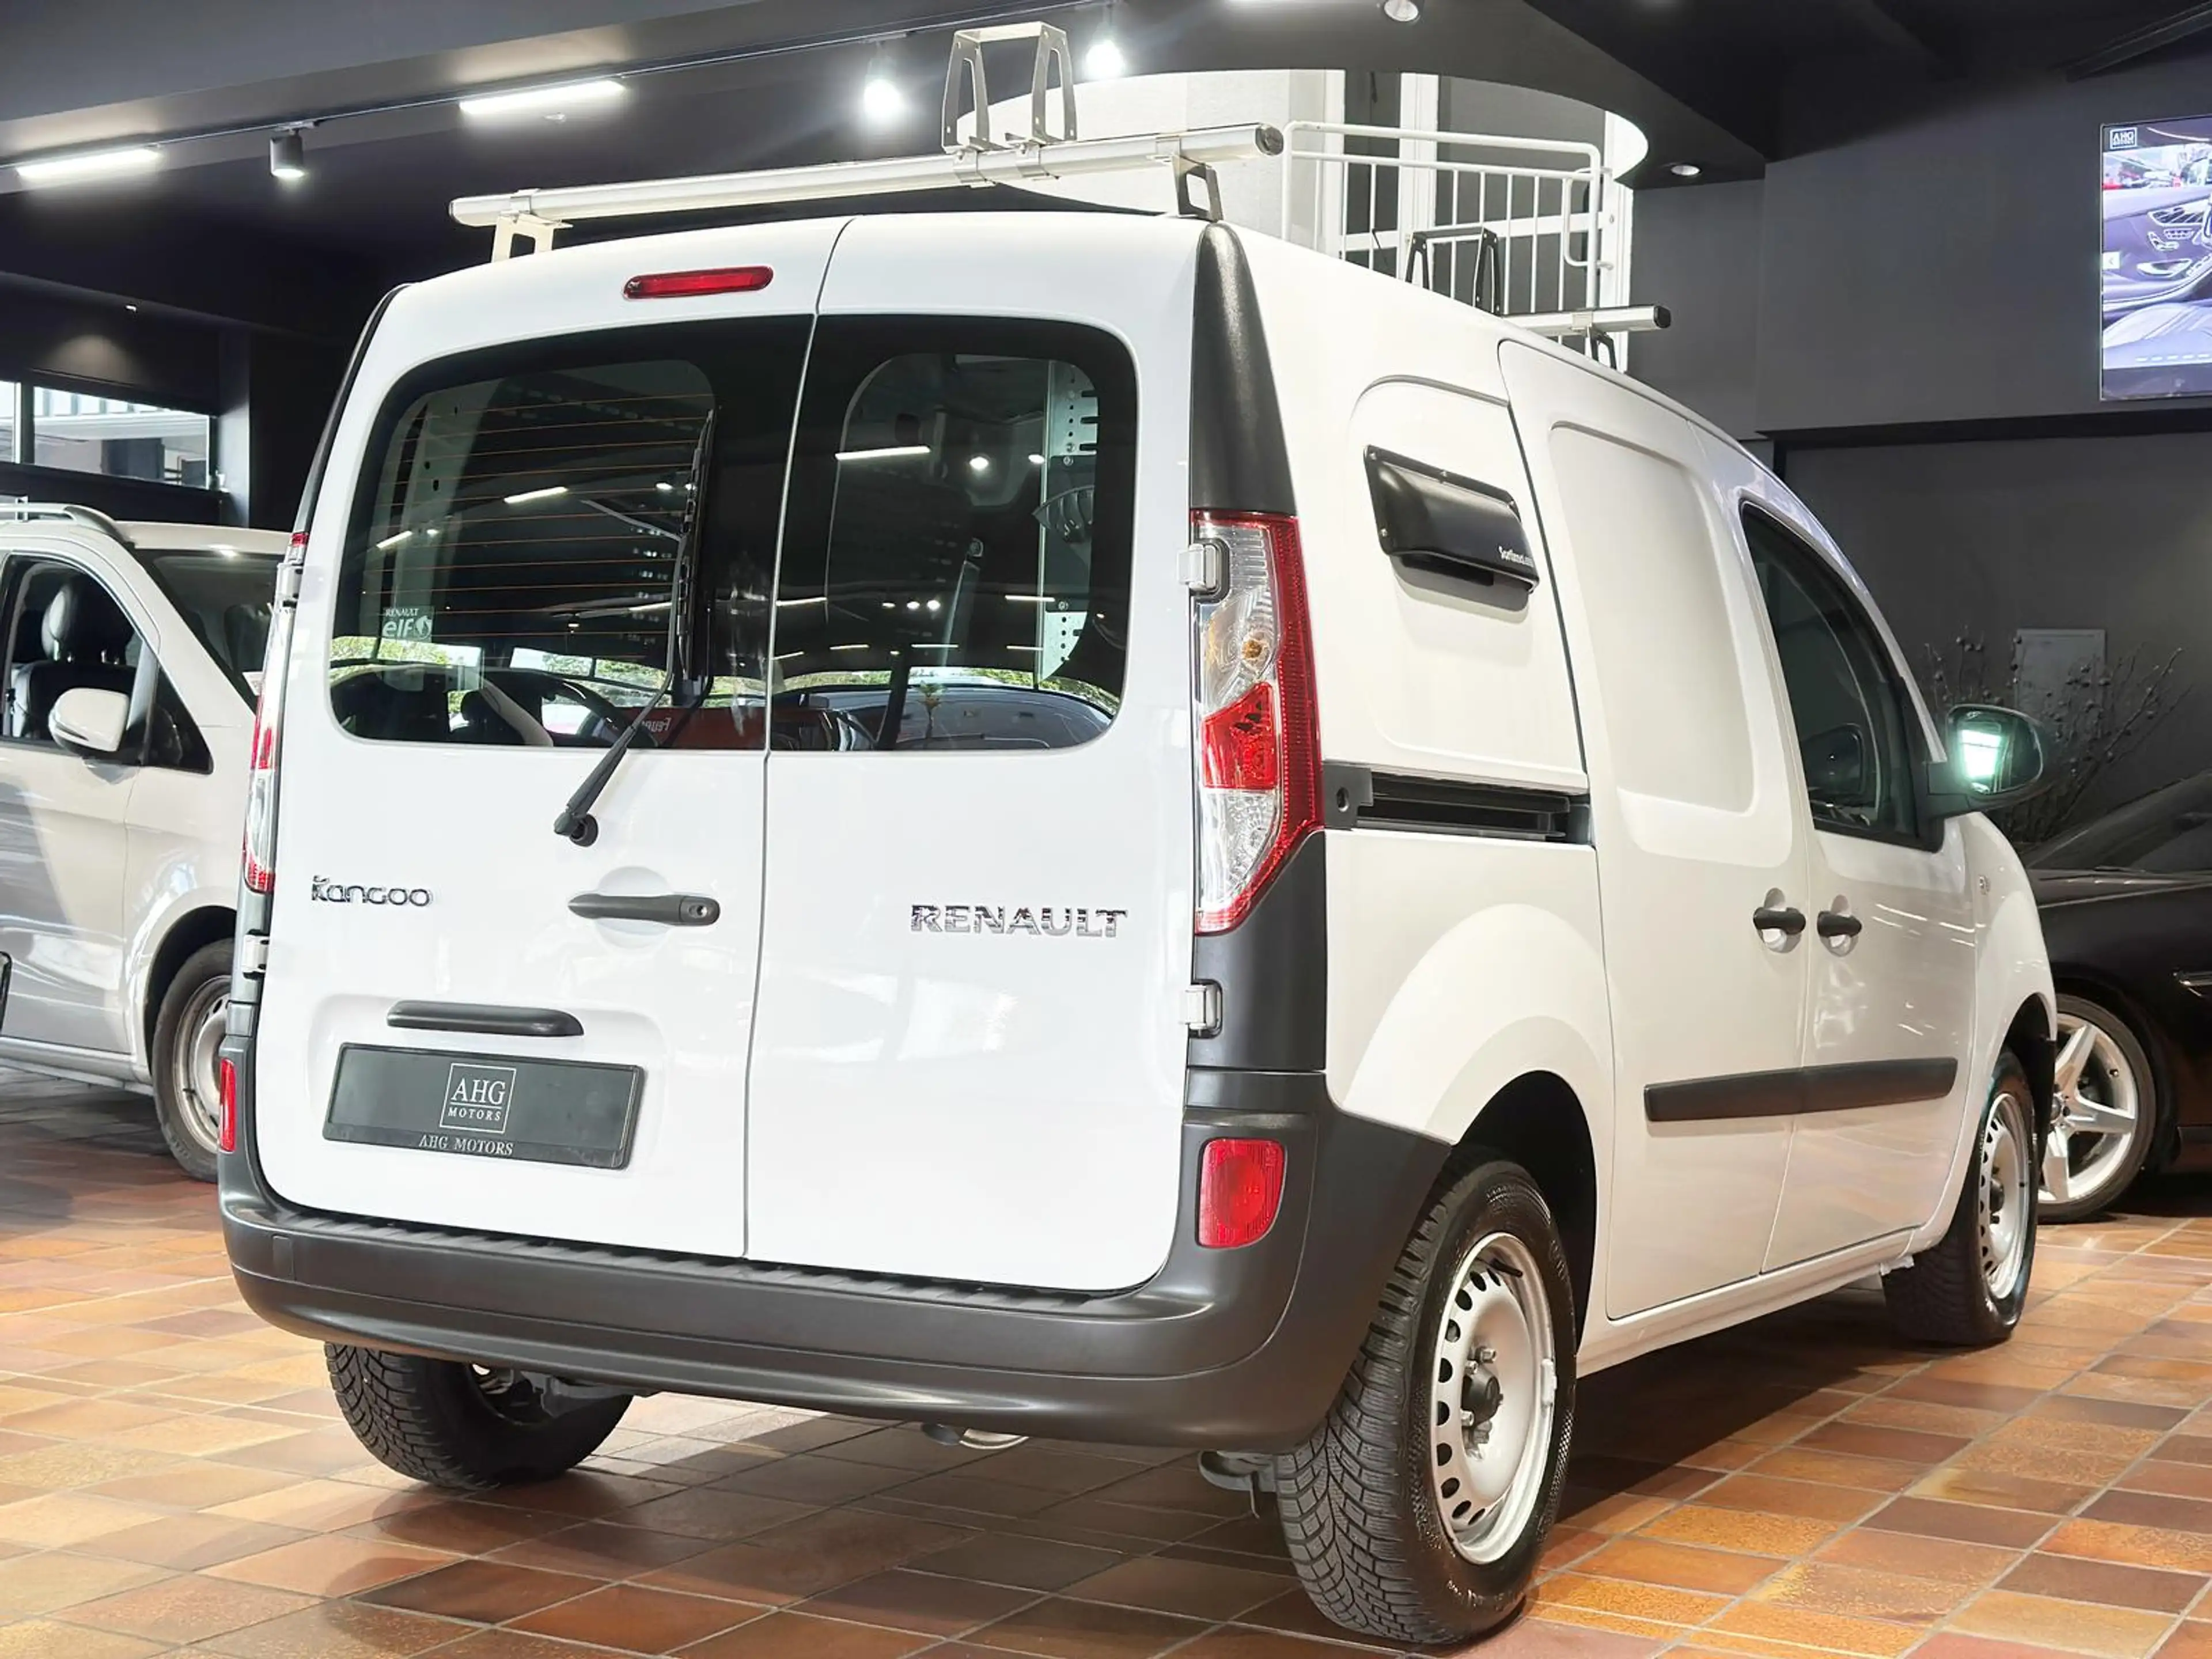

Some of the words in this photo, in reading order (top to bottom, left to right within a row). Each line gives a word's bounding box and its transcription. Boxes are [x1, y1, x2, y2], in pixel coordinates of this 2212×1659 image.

[910, 904, 1128, 938] RENAULT
[450, 1078, 506, 1105] AHG
[448, 1107, 502, 1121] MOTORS
[419, 1134, 448, 1150] AHG
[454, 1137, 514, 1156] MOTORS
